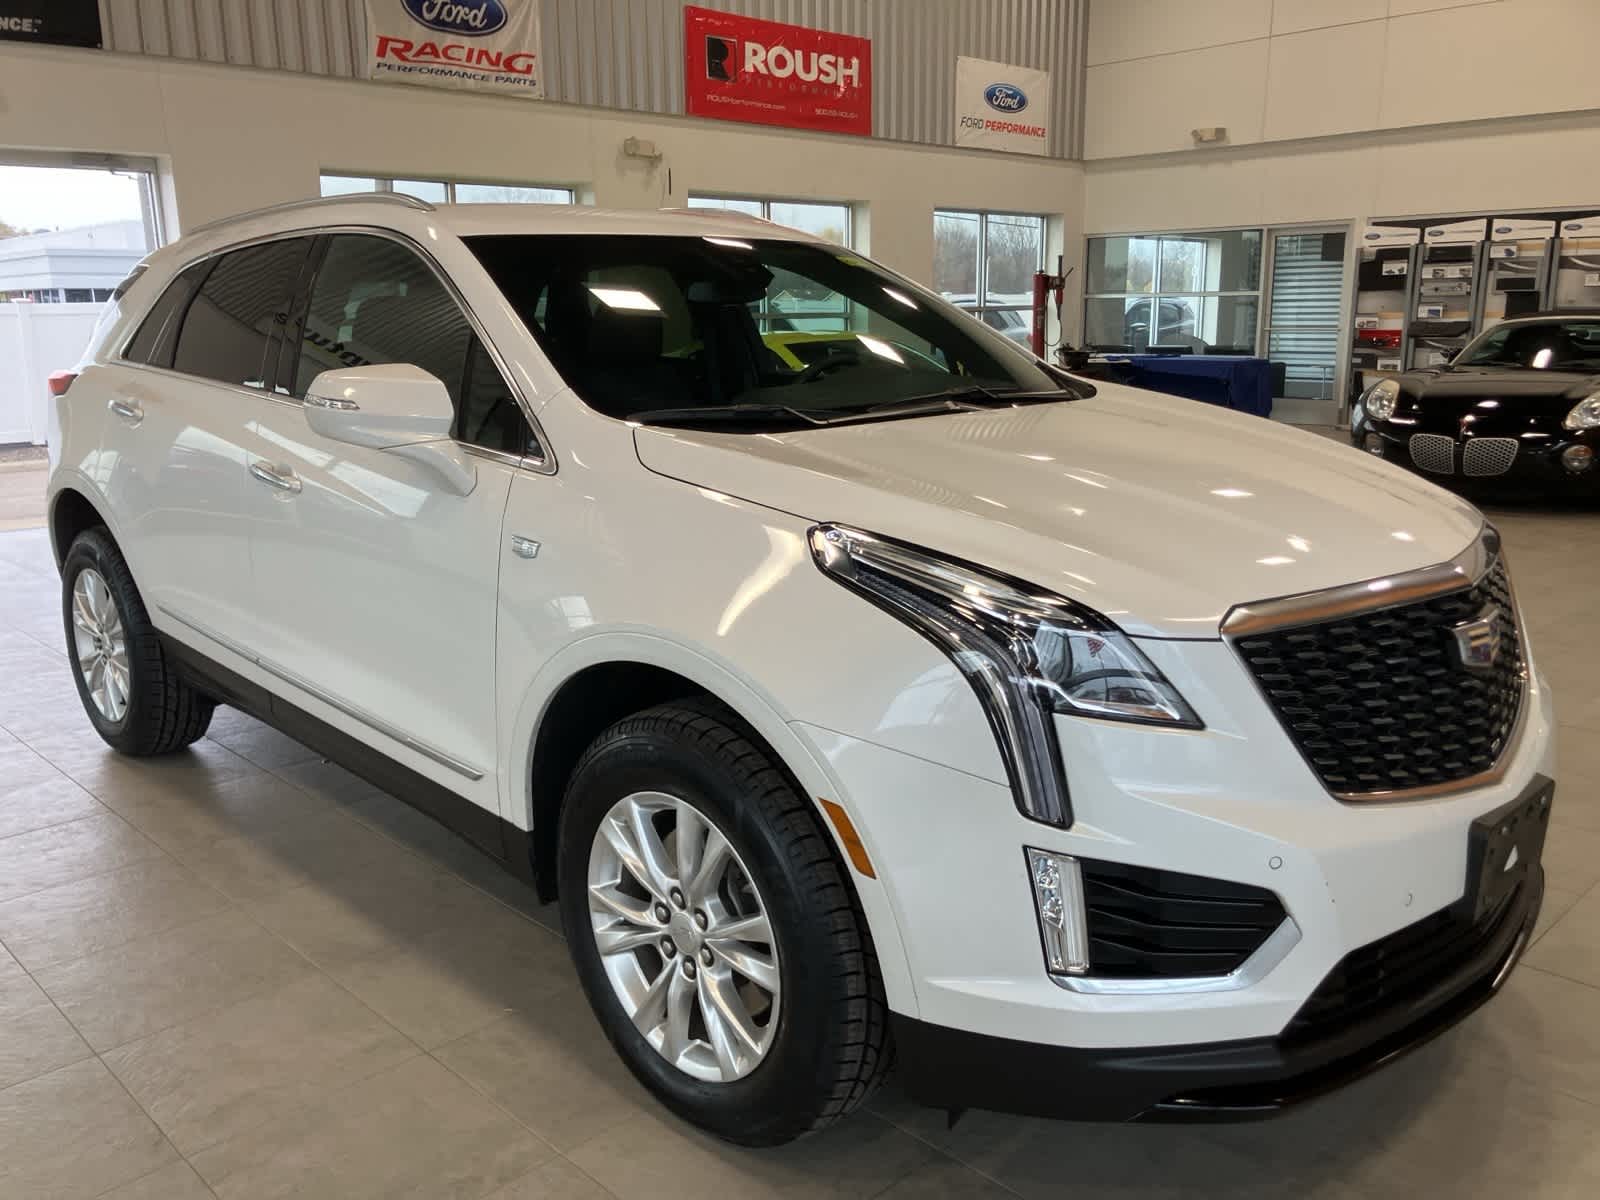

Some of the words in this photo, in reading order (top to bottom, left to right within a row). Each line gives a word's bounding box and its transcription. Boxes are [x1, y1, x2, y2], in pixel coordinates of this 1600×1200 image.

[422, 0, 488, 28] Ford
[376, 35, 536, 75] RACING
[744, 41, 860, 88] ROUSH
[376, 62, 490, 82] PERFORMANCE
[495, 75, 537, 87] PARTS
[992, 87, 1020, 109] Ford
[960, 116, 984, 130] FORD
[985, 119, 1047, 138] PERFORMANCE
